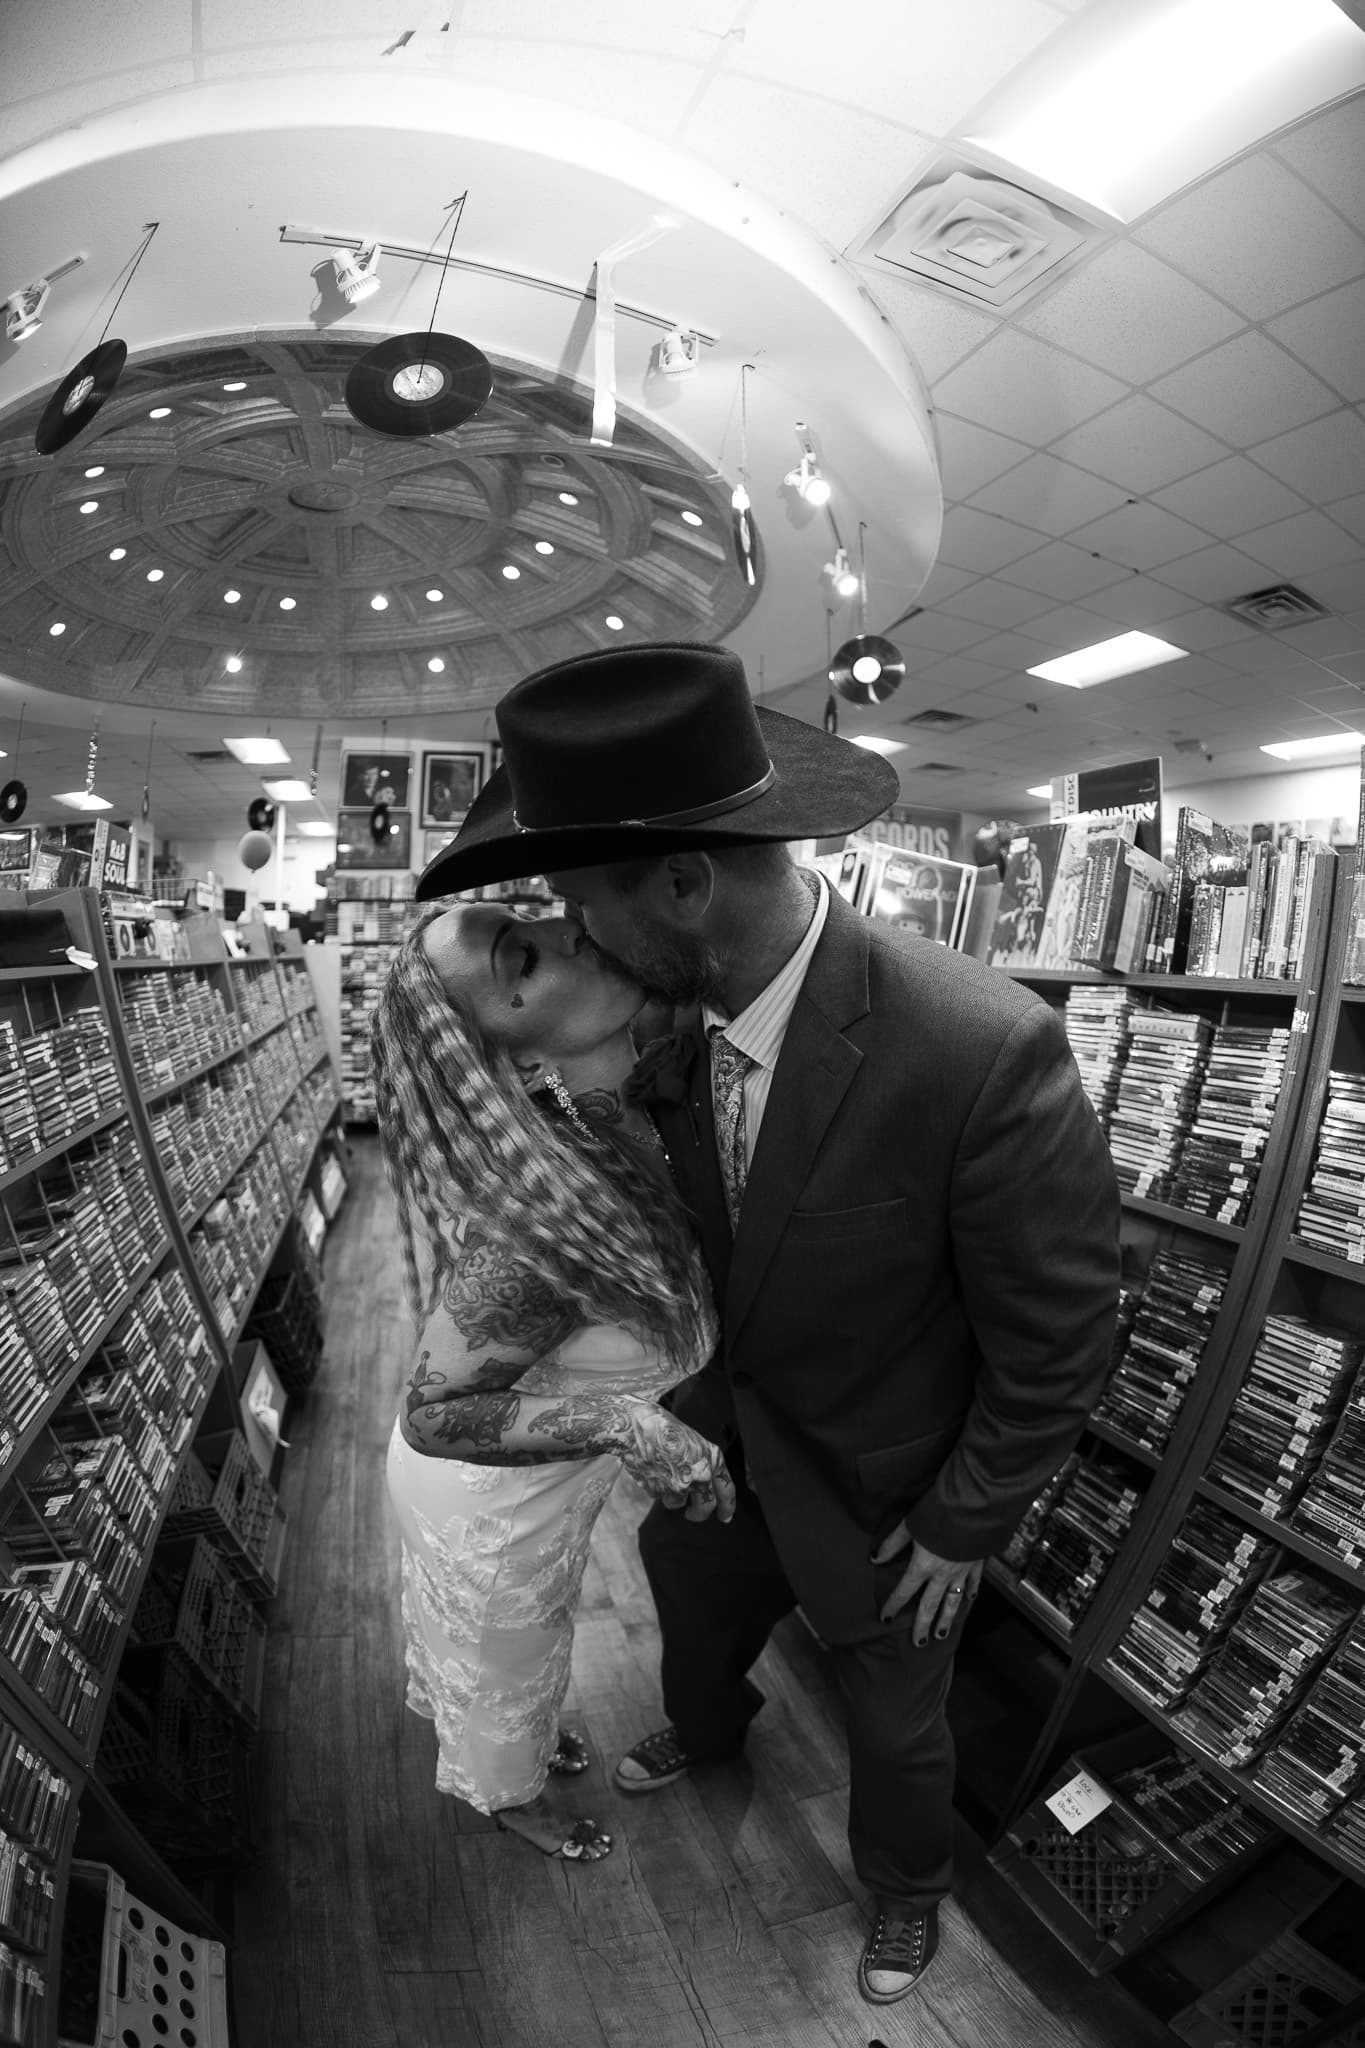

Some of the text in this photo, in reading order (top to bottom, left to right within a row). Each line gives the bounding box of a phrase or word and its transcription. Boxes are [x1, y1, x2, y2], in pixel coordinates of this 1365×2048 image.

[110, 839, 126, 861] R&B
[865, 820, 949, 859] CORDS
[104, 862, 126, 885] SOUL
